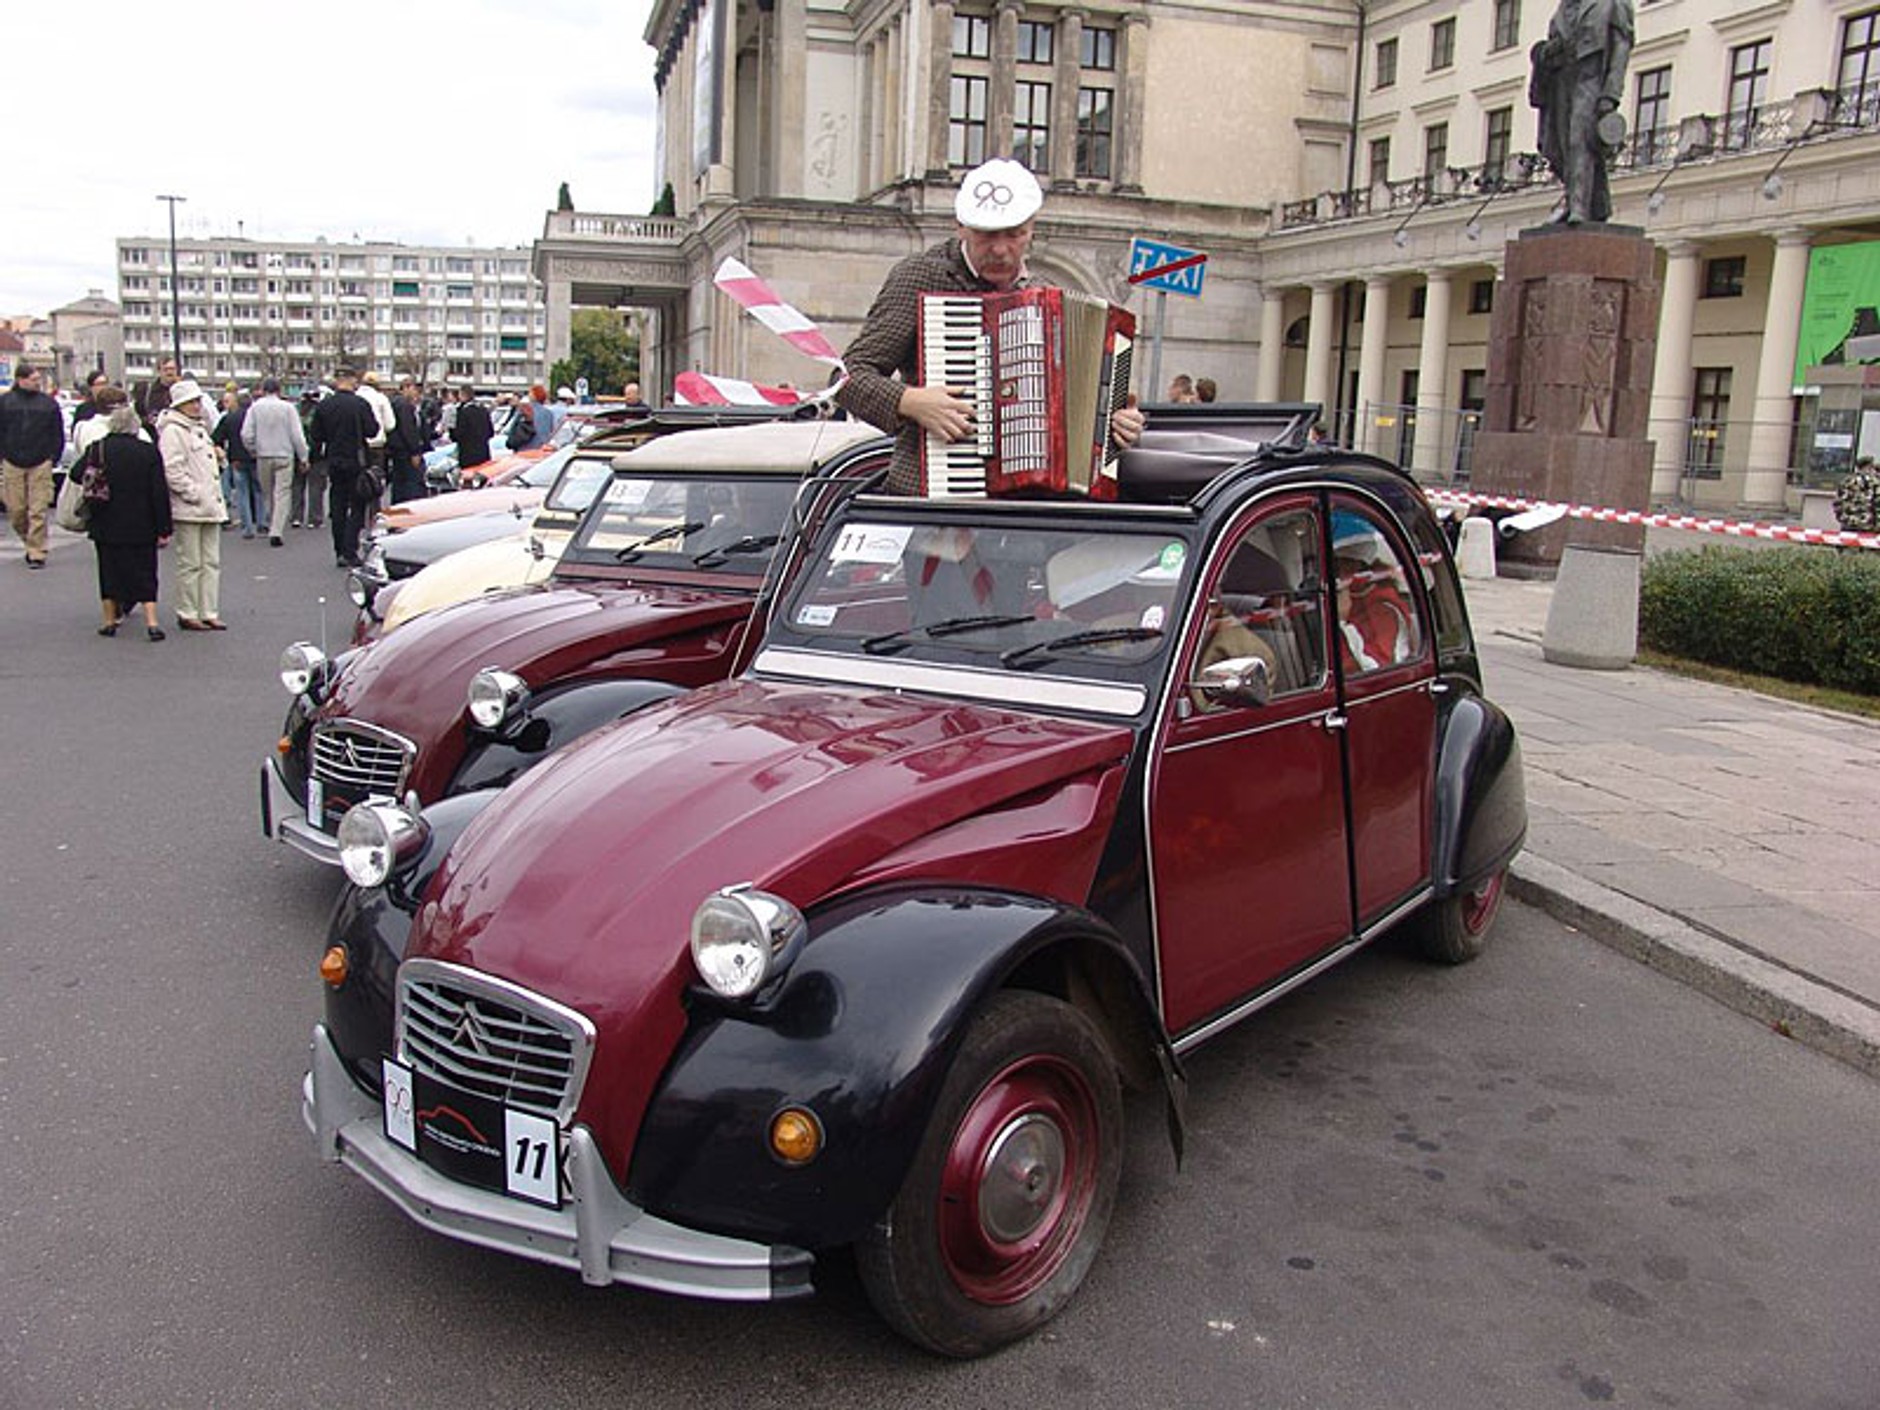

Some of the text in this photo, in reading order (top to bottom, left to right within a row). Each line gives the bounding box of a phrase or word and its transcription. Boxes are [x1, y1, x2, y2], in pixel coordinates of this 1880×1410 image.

[973, 181, 1014, 208] 90
[1135, 246, 1202, 290] TAXI
[841, 533, 866, 553] 11
[515, 1137, 548, 1180] 11
